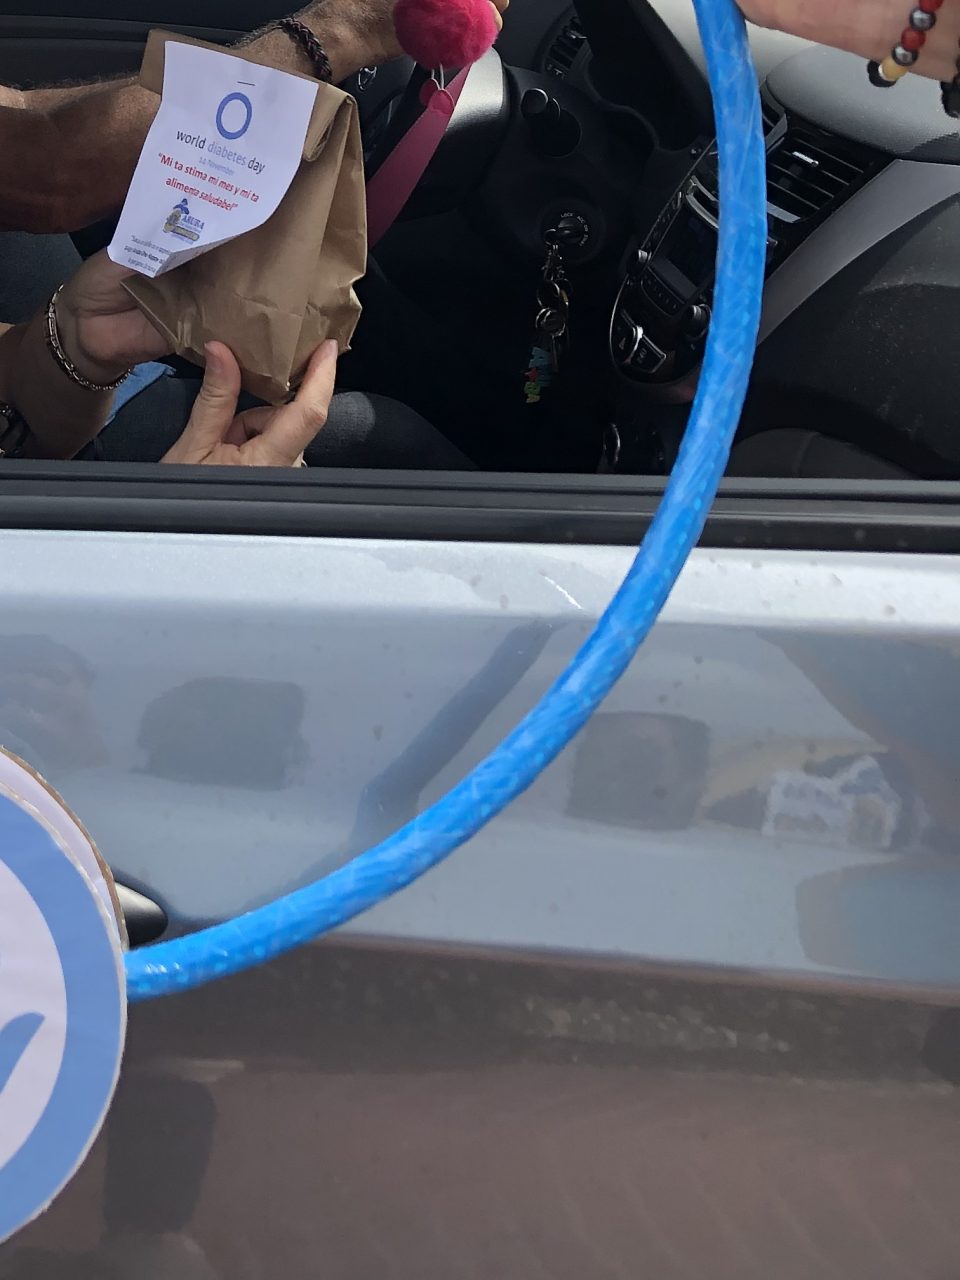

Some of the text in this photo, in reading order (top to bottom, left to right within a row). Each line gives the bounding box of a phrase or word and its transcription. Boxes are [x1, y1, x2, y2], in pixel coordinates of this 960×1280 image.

[176, 130, 266, 175] world diabetes day
[174, 160, 184, 171] ta
[184, 165, 208, 181] stima
[208, 176, 220, 186] mi
[218, 180, 234, 192] mes
[233, 187, 241, 196] y
[240, 189, 252, 199] mi
[250, 193, 260, 203] ta
